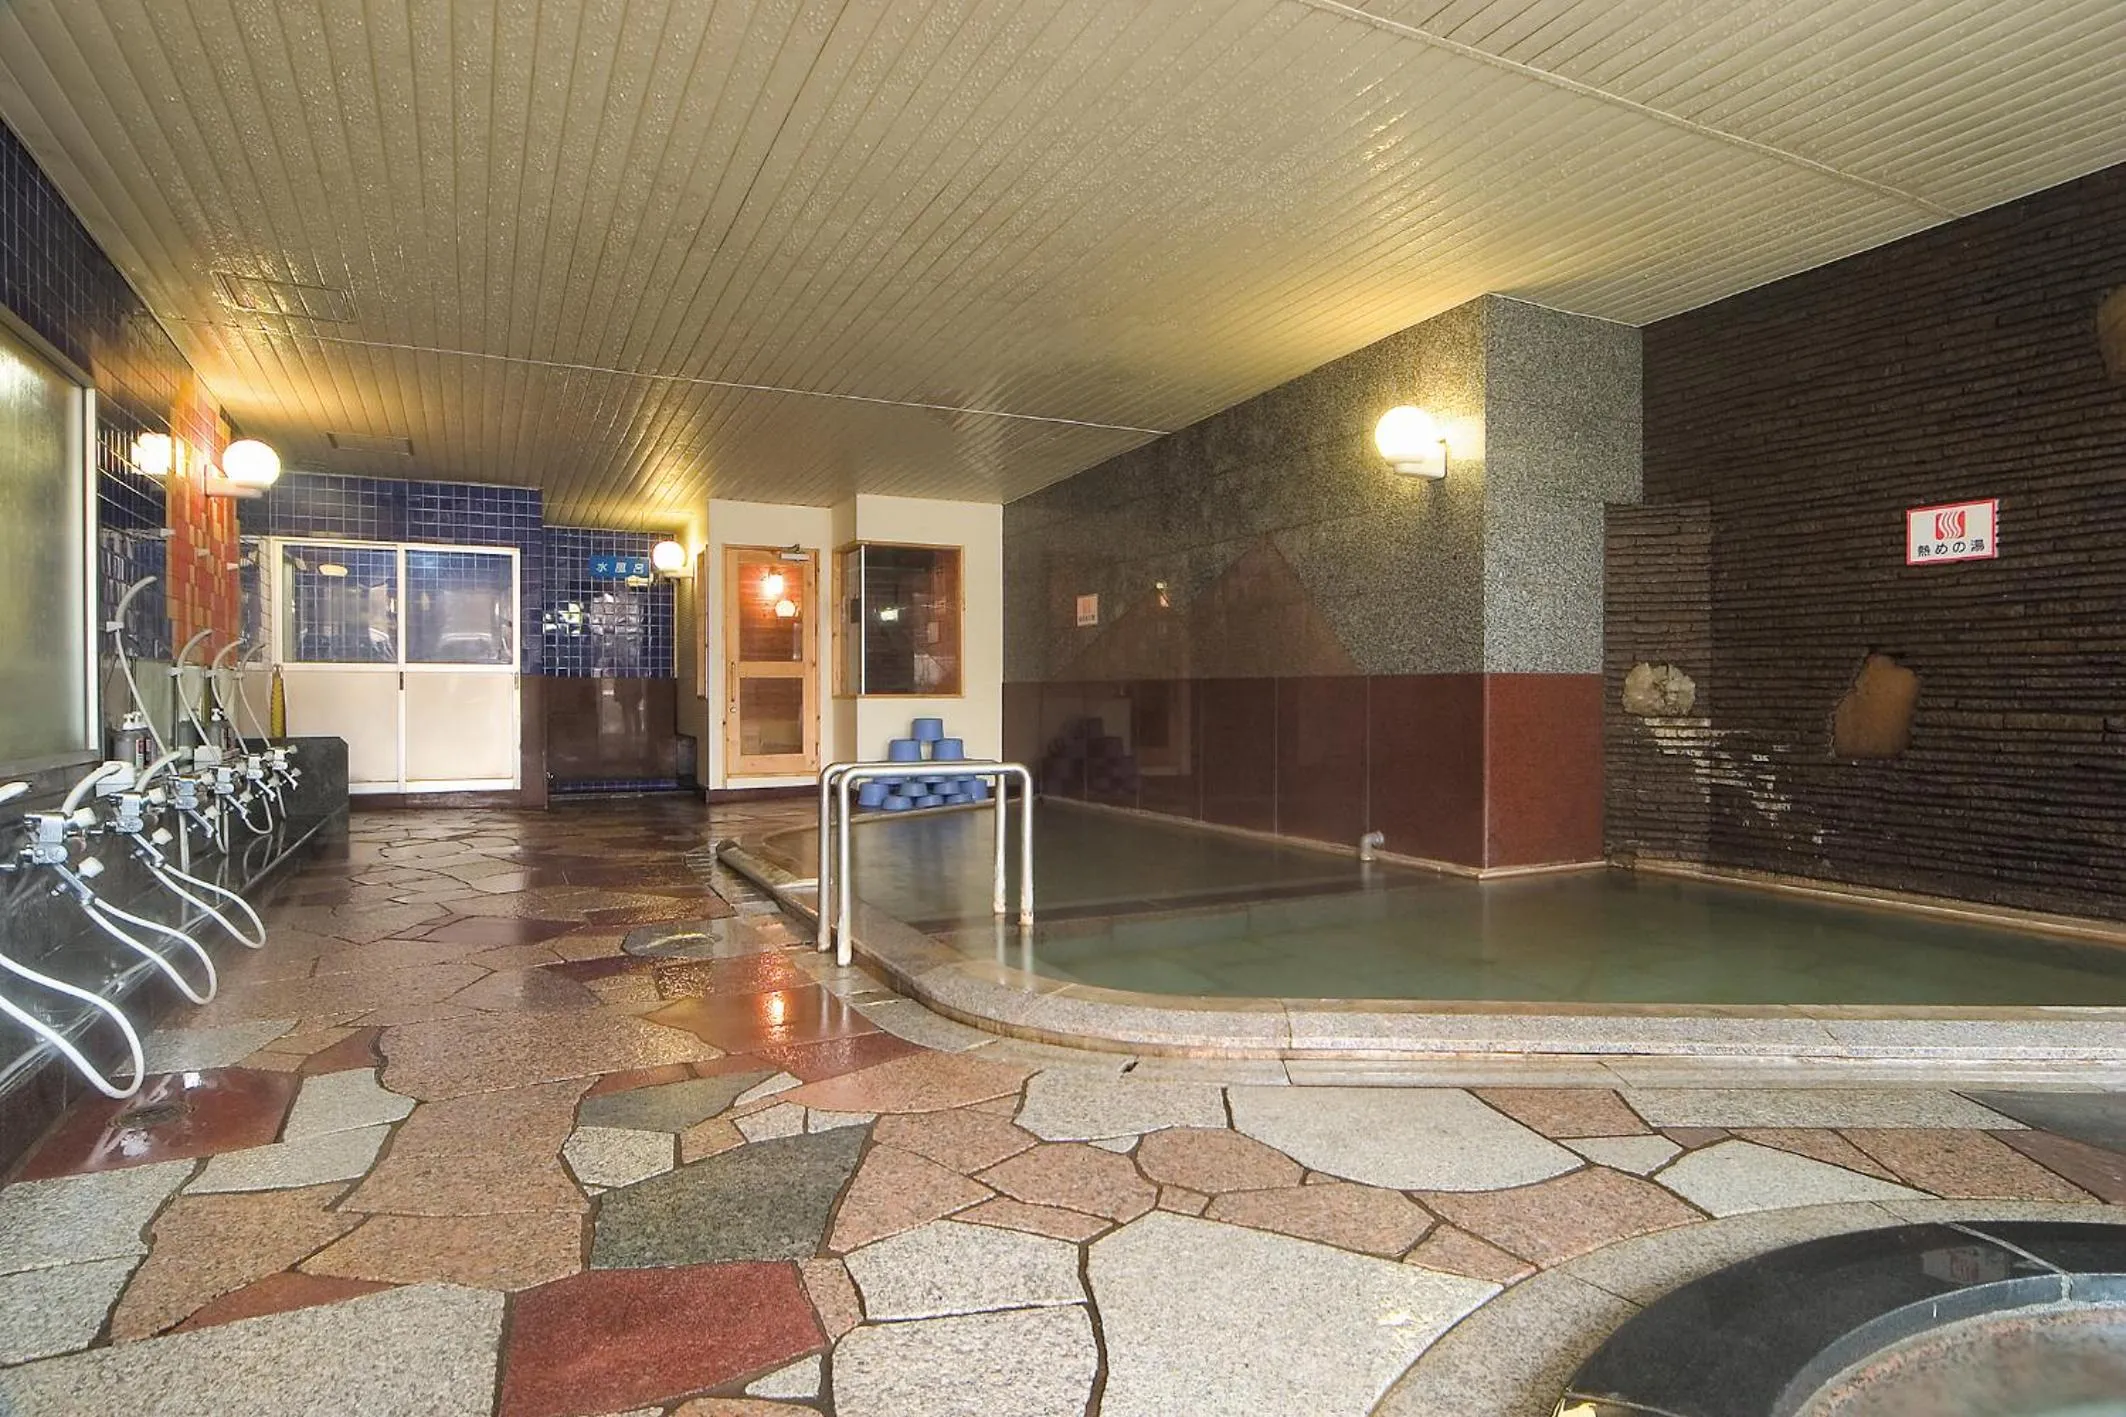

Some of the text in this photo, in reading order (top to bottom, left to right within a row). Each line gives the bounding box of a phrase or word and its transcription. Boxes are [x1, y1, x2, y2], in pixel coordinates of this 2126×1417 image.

[1917, 539, 1985, 557] 熱めの湯
[596, 562, 644, 574] 水風呂
